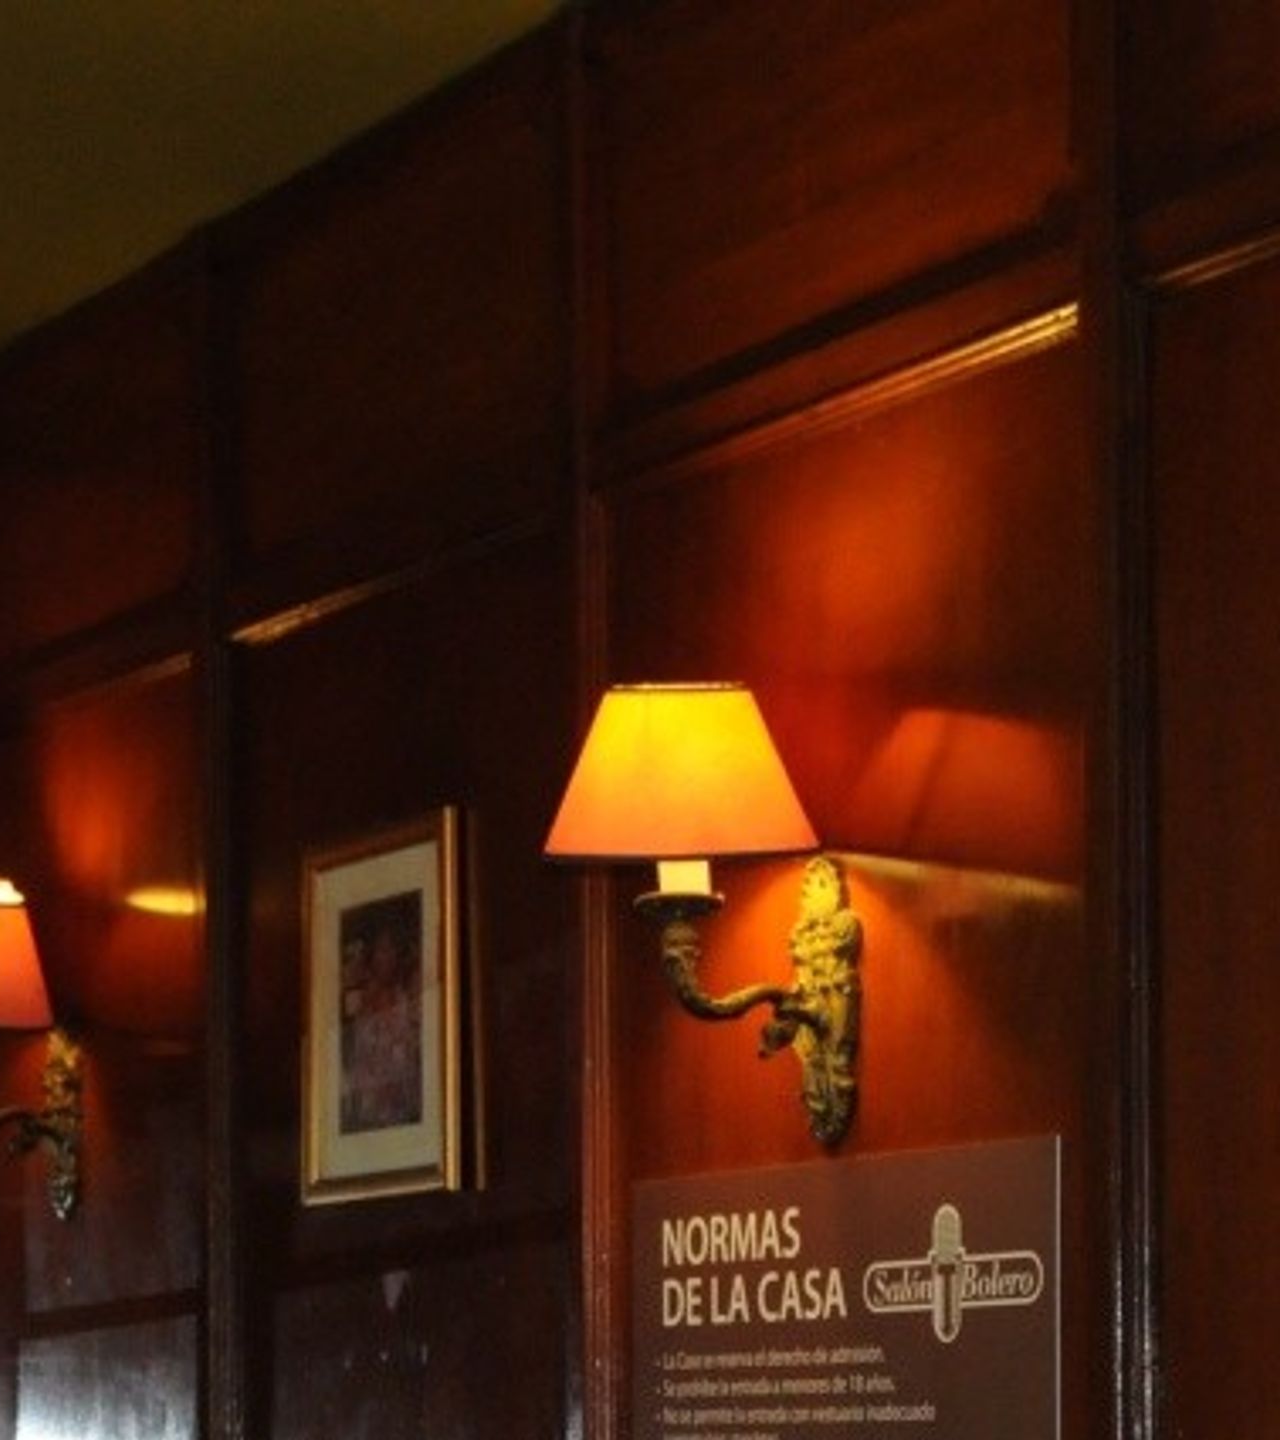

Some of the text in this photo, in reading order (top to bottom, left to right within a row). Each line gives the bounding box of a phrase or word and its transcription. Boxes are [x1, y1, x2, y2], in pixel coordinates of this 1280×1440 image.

[662, 1206, 801, 1268] NORMAS
[662, 1266, 849, 1328] DE LA CASA
[872, 1260, 1035, 1306] Salón Bolero
